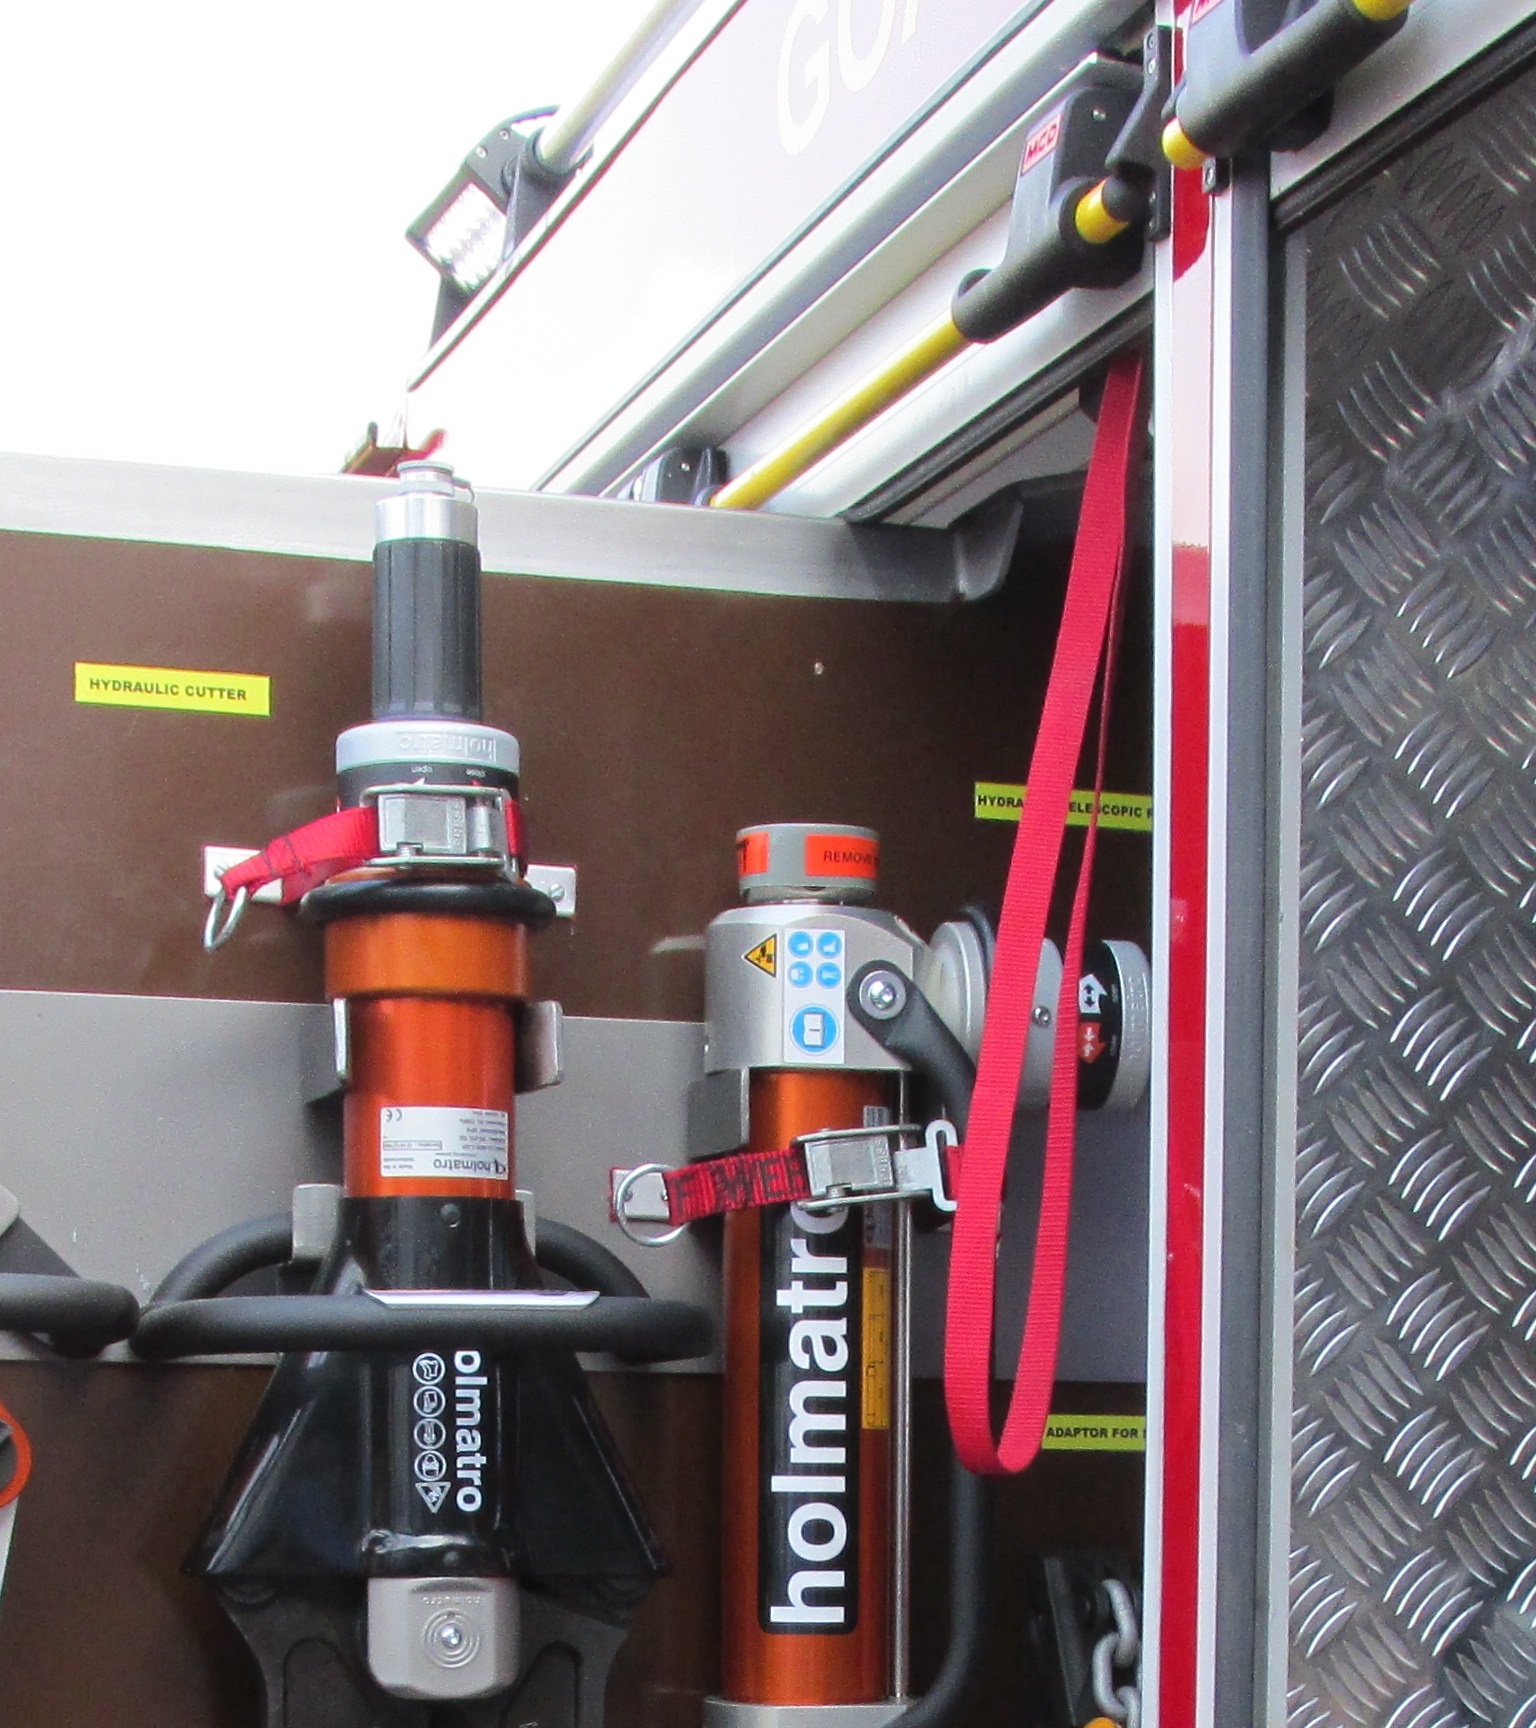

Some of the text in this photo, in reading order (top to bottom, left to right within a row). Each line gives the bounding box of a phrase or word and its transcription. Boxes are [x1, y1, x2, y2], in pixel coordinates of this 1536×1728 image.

[89, 678, 247, 701] HYDRAULIC CUTTER
[432, 1158, 492, 1173] holmatro
[454, 1350, 488, 1513] olmatro
[1046, 1427, 1108, 1438] ADAPTOR
[1112, 1428, 1139, 1438] FOR
